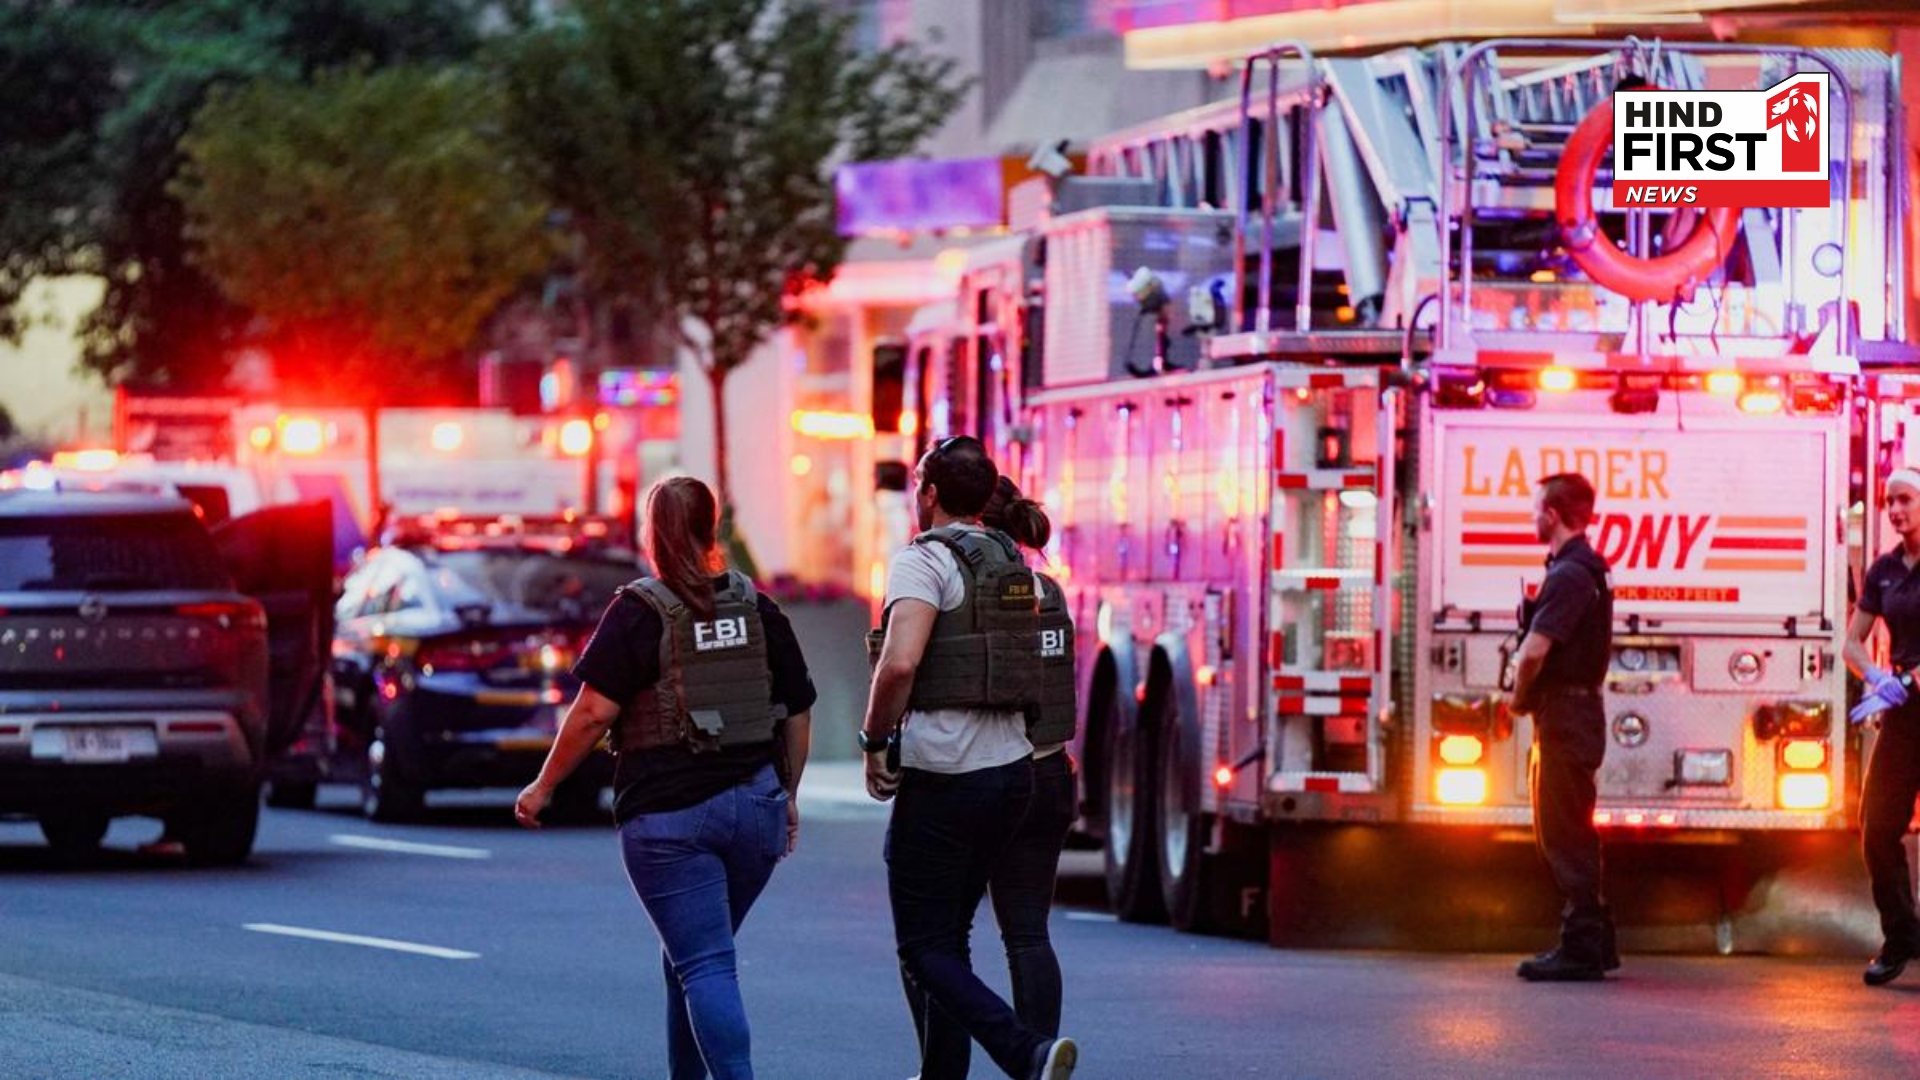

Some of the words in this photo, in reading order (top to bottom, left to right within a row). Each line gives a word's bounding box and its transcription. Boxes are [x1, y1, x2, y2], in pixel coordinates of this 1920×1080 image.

[1462, 446, 1670, 500] LADDER
[1590, 513, 1710, 570] DNY
[694, 616, 747, 642] FBI
[1040, 629, 1064, 649] BI
